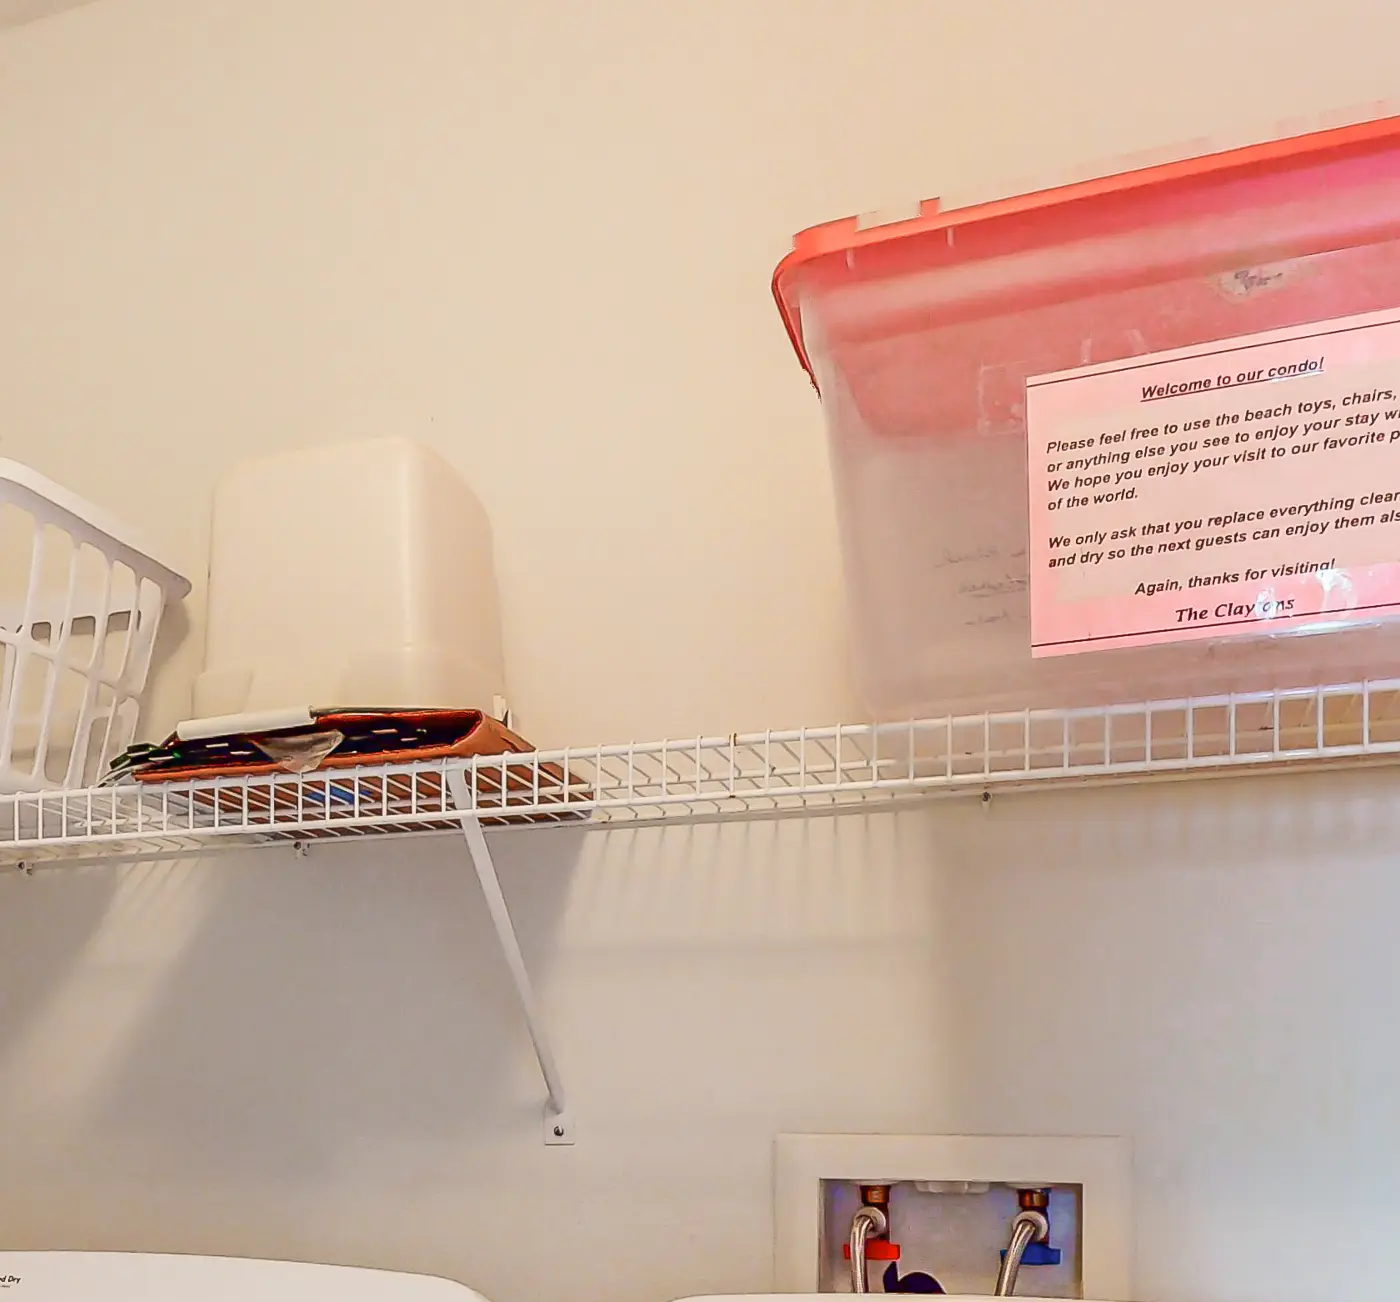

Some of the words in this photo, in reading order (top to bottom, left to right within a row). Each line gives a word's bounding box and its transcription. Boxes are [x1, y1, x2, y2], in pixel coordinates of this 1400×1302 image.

[1141, 378, 1211, 398] Welcome
[1217, 375, 1231, 386] to
[1237, 370, 1264, 382] our
[1268, 357, 1324, 377] condo!
[1046, 438, 1095, 453] Please
[1100, 430, 1126, 445] feel
[1130, 427, 1159, 440] free
[1164, 423, 1178, 435] to
[1183, 419, 1211, 431] use
[1216, 413, 1239, 427] the
[1245, 404, 1292, 422] beach
[1298, 399, 1336, 414] toys,
[1342, 389, 1397, 406] chairs,
[1047, 462, 1062, 472] or
[1066, 451, 1130, 470] anything
[1135, 446, 1165, 459] else
[1169, 441, 1198, 457] you
[1203, 435, 1230, 448] see
[1235, 432, 1249, 443] to
[1255, 425, 1299, 441] enjoy
[1303, 418, 1341, 436] your
[1345, 412, 1380, 427] stay
[1384, 410, 1400, 421] w
[1048, 478, 1070, 492] We
[1074, 474, 1111, 489] hope
[1115, 469, 1142, 484] you
[1148, 462, 1189, 477] enjoy
[1193, 455, 1229, 473] your
[1233, 448, 1266, 463] visit
[1271, 447, 1286, 459] to
[1291, 442, 1319, 455] our
[1323, 432, 1385, 450] favorite
[1048, 498, 1063, 510] of
[1066, 495, 1089, 508] the
[1093, 487, 1138, 504] world.
[1048, 536, 1071, 549] We
[1075, 531, 1107, 545] only
[1110, 526, 1137, 540] ask
[1141, 522, 1170, 536] that
[1174, 518, 1202, 534] you
[1207, 510, 1264, 528] replace
[1270, 497, 1355, 518] everything
[1048, 553, 1076, 568] and
[1080, 551, 1104, 565] dry
[1107, 549, 1126, 560] so
[1130, 544, 1153, 557] the
[1157, 539, 1192, 553] next
[1195, 532, 1247, 551] guests
[1252, 528, 1280, 540] can
[1285, 521, 1330, 537] enjoy
[1334, 515, 1375, 529] them
[1135, 579, 1183, 596] Again,
[1188, 572, 1240, 588] thanks
[1245, 568, 1267, 581] for
[1175, 607, 1208, 622] The
[1214, 599, 1295, 617] Clayons
